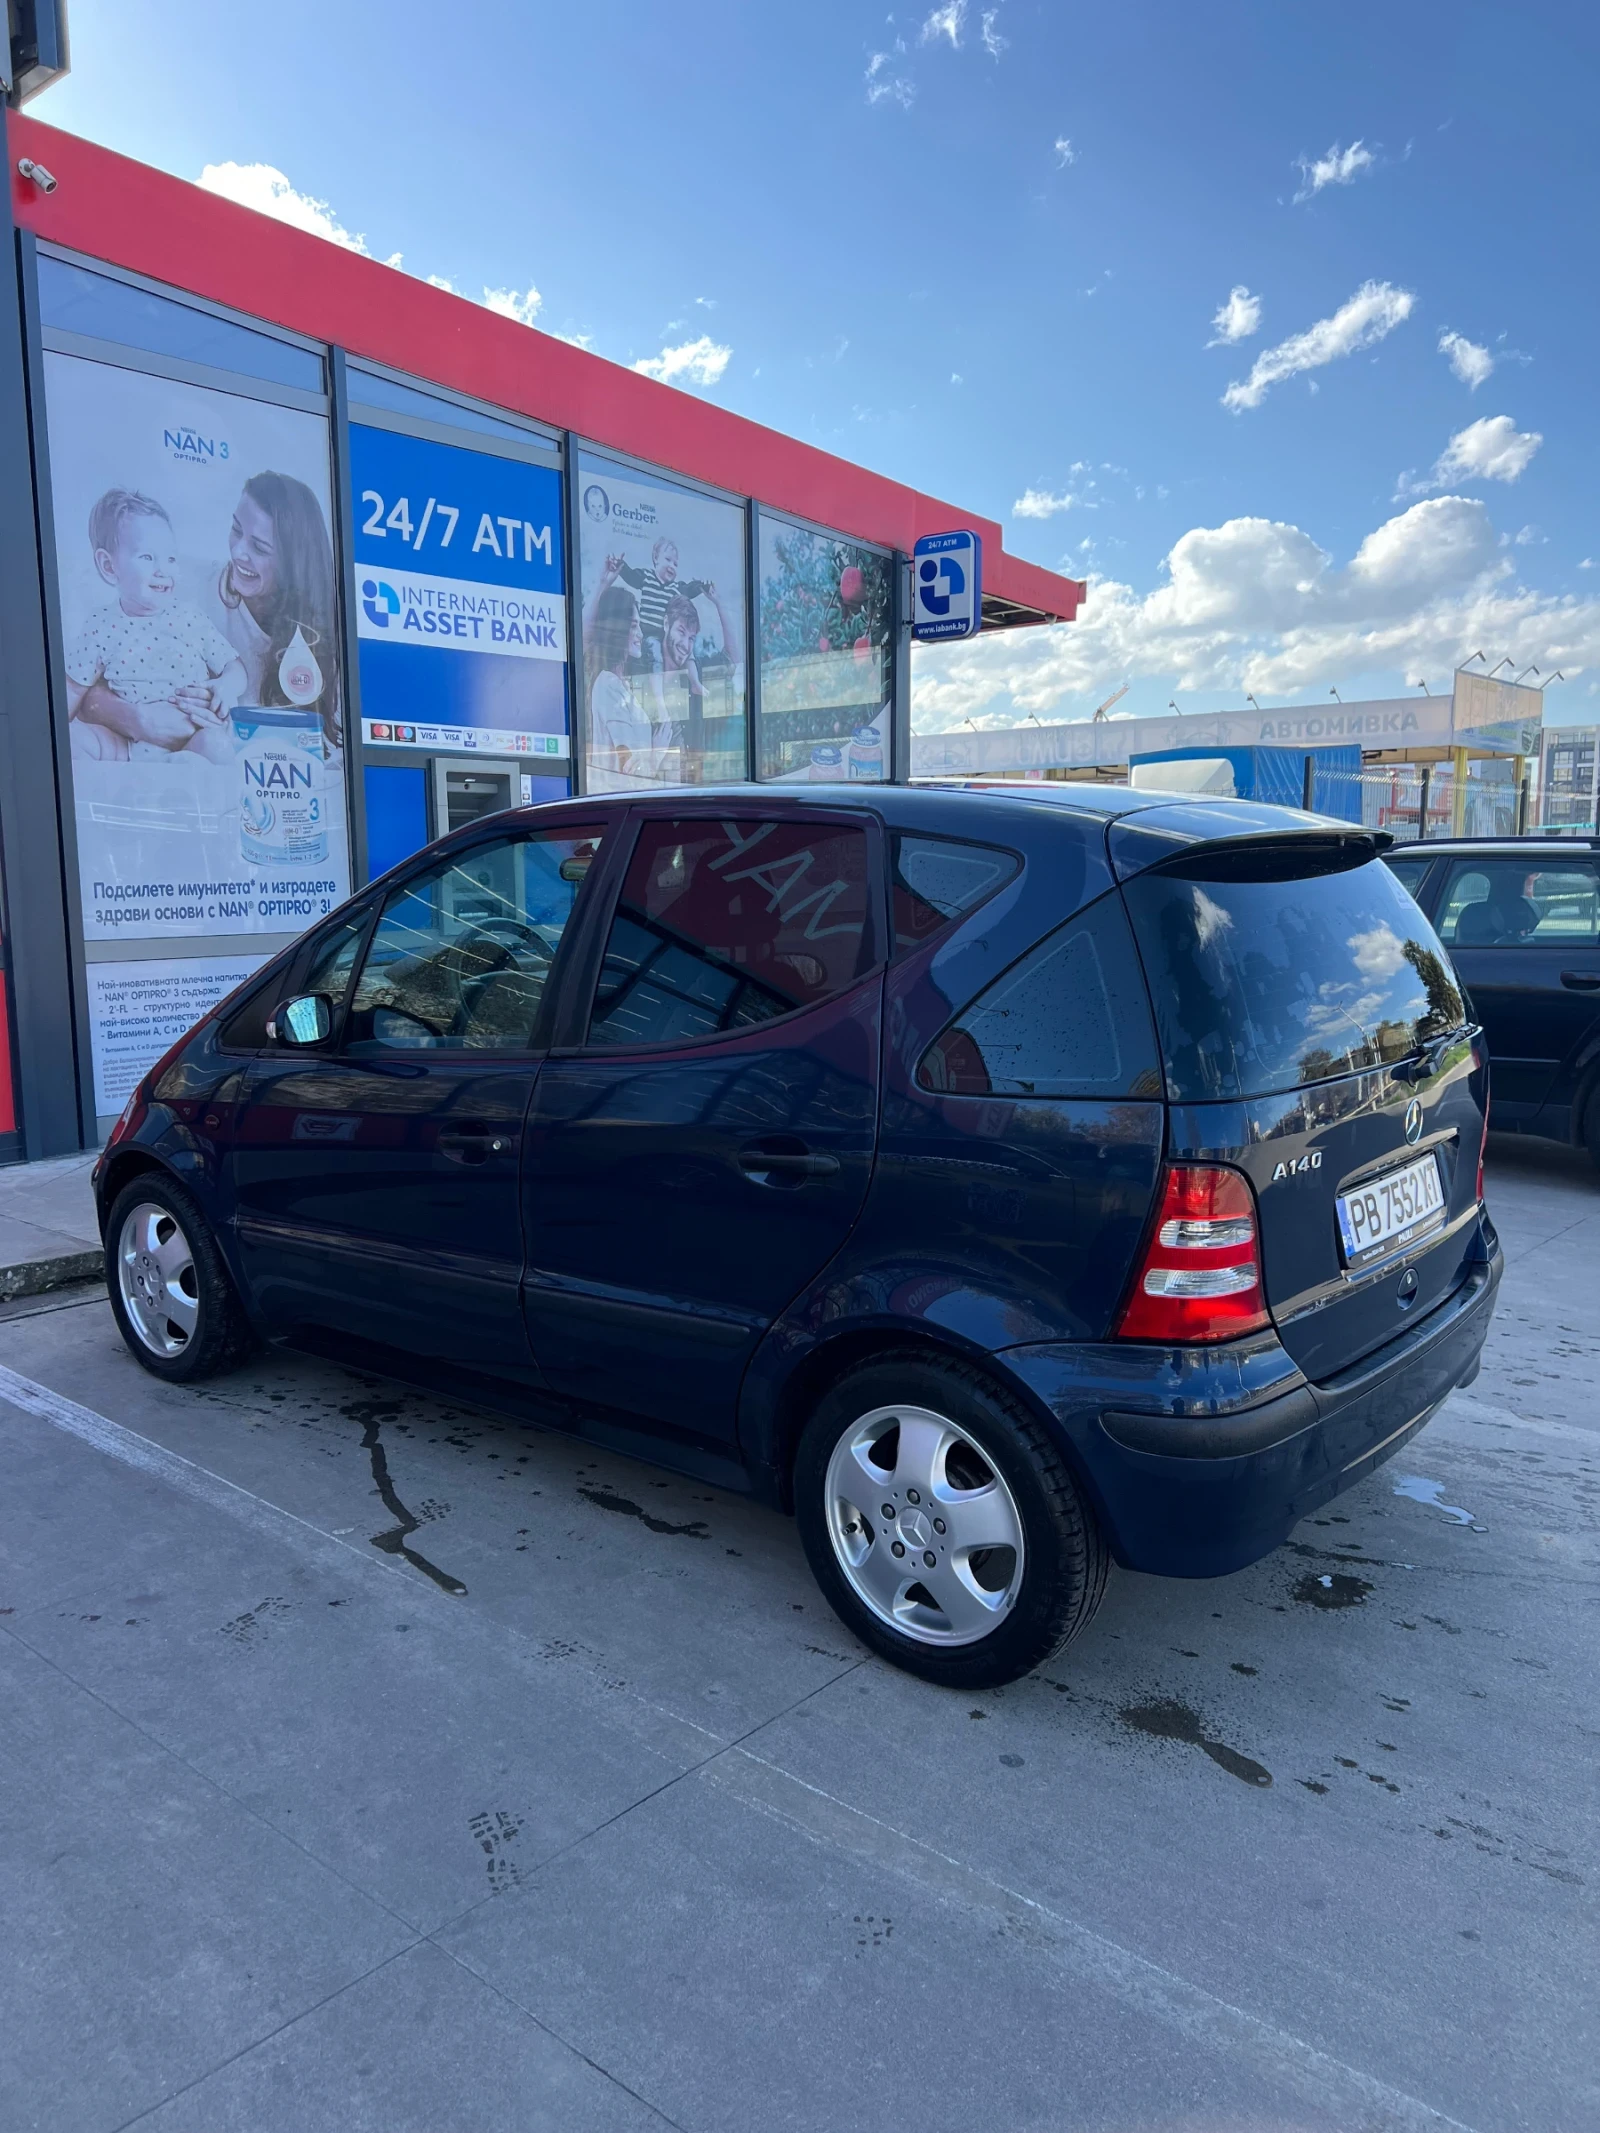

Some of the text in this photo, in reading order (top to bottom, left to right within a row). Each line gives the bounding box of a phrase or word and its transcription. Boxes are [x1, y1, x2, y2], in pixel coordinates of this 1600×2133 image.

[164, 429, 229, 460] NAN 3
[173, 452, 207, 464] OPTIPRO
[612, 503, 657, 524] Gerber
[362, 490, 552, 565] 24/7 ATM
[928, 538, 957, 549] 24/7 ATM
[402, 586, 557, 624] INTERNATIONAL
[403, 607, 558, 649] ASSET BANK
[421, 732, 437, 740] VISA
[1260, 712, 1419, 739] АВТОМИВКА
[444, 733, 460, 741] VISA
[244, 759, 311, 789] NAN
[256, 790, 301, 800] OPTIPRO
[310, 798, 320, 821] 3
[94, 882, 174, 902] Подсилете
[260, 883, 268, 895] и
[271, 880, 336, 897] изградете
[95, 908, 150, 926] здрави
[154, 904, 204, 921] основи
[321, 898, 331, 914] 3!
[97, 973, 248, 990] Най-иновативната млечна напитка
[174, 988, 180, 997] 3
[181, 986, 222, 998] съдържа:
[143, 1002, 191, 1013] структурно
[100, 1012, 200, 1028] най-високо количество
[107, 1028, 151, 1040] Витамини
[172, 1026, 178, 1034] и
[180, 1024, 187, 1033] D
[1272, 1151, 1323, 1181] A140
[1350, 1193, 1382, 1244] PB
[1380, 1174, 1424, 1230] 7552
